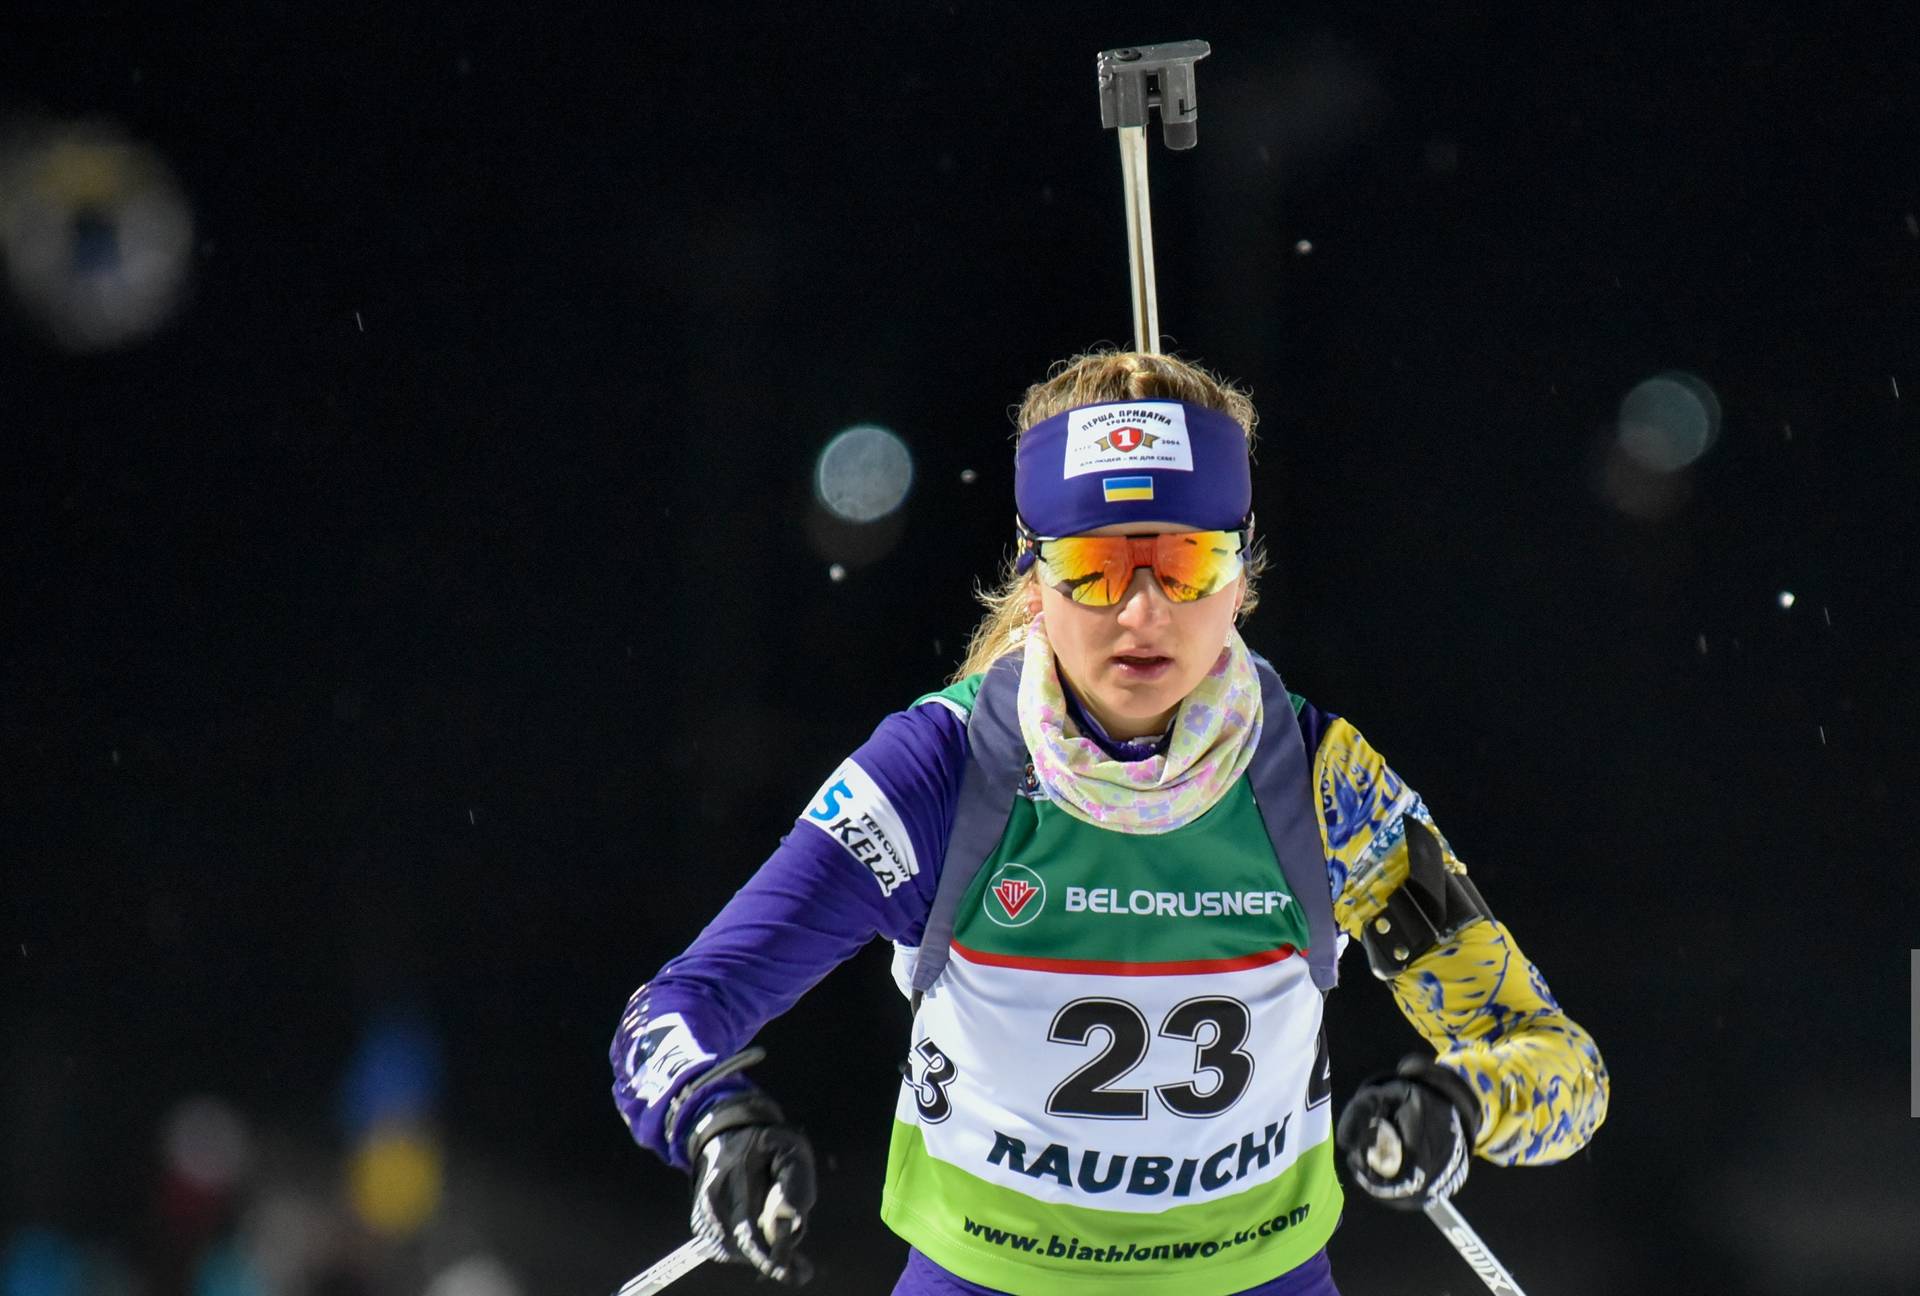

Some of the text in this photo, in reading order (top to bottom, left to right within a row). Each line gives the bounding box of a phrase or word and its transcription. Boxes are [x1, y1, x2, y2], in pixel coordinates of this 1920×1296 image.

[1081, 409, 1172, 432] ПЕРША ПРИВАТНА
[1117, 429, 1134, 447] 1
[1065, 886, 1292, 917] BELORUSNEFT
[903, 1036, 959, 1125] 3
[1046, 996, 1256, 1121] 23
[986, 1111, 1292, 1197] RAUBICHI
